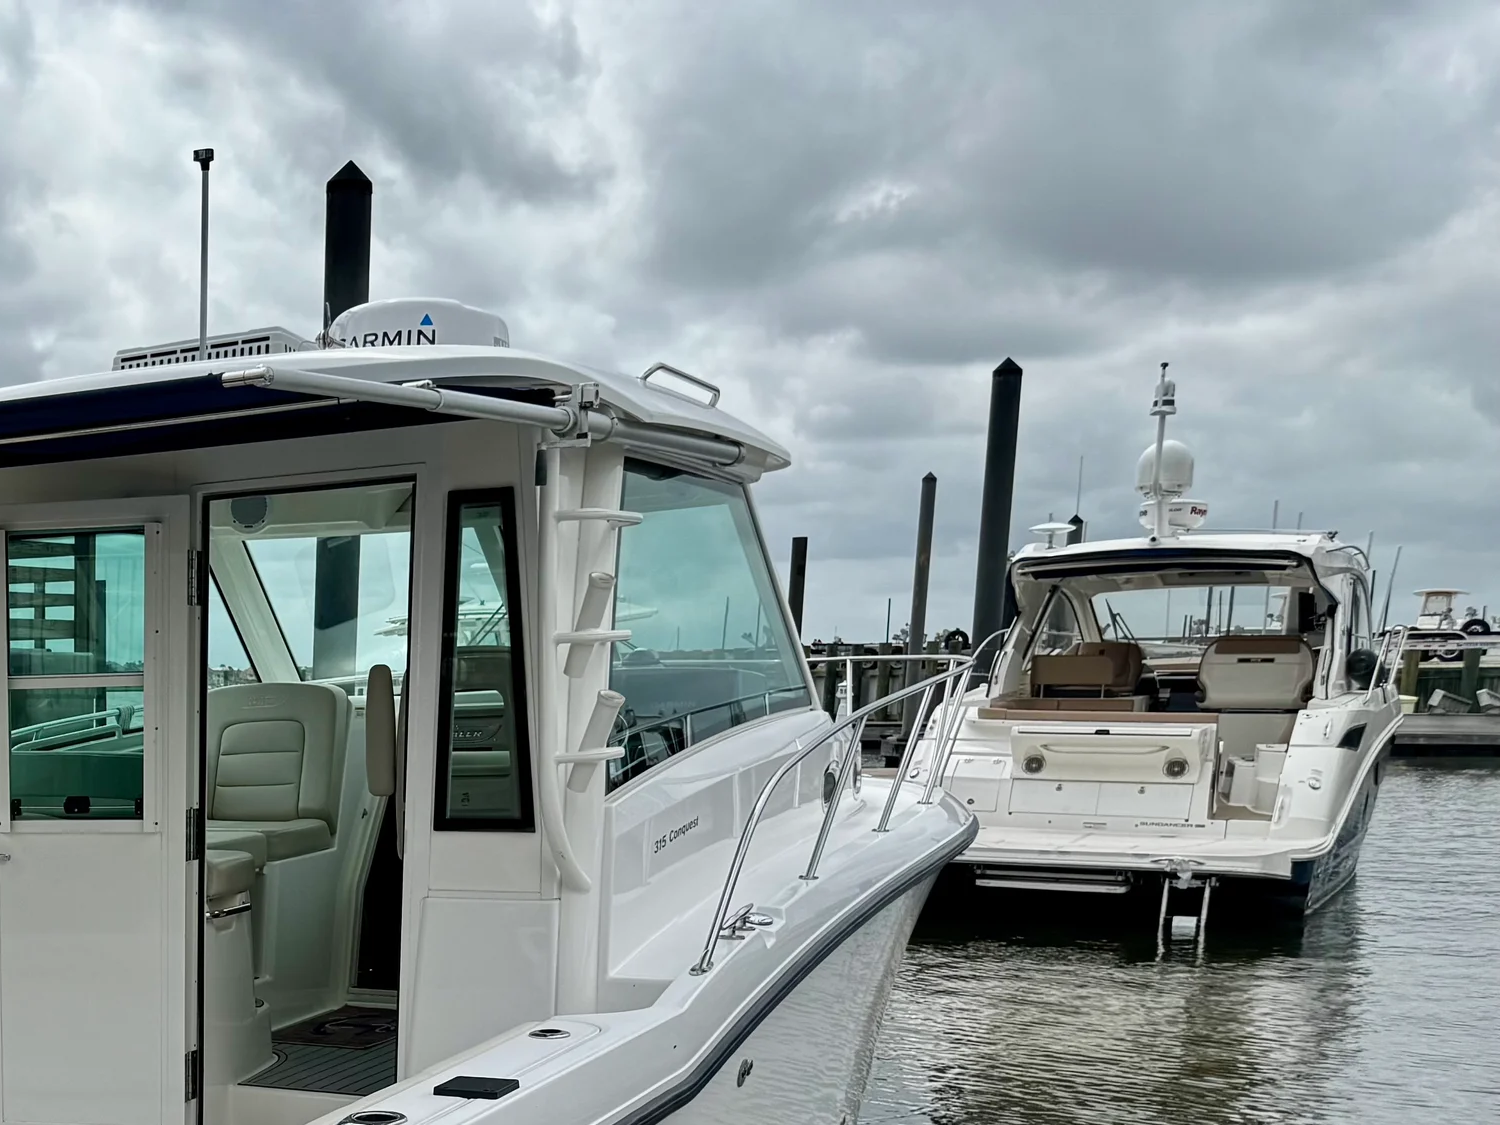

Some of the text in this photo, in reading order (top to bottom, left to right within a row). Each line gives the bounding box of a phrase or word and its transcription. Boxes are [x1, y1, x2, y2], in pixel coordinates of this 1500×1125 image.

[341, 329, 436, 347] ARMIN
[653, 815, 699, 854] 315 Conquest
